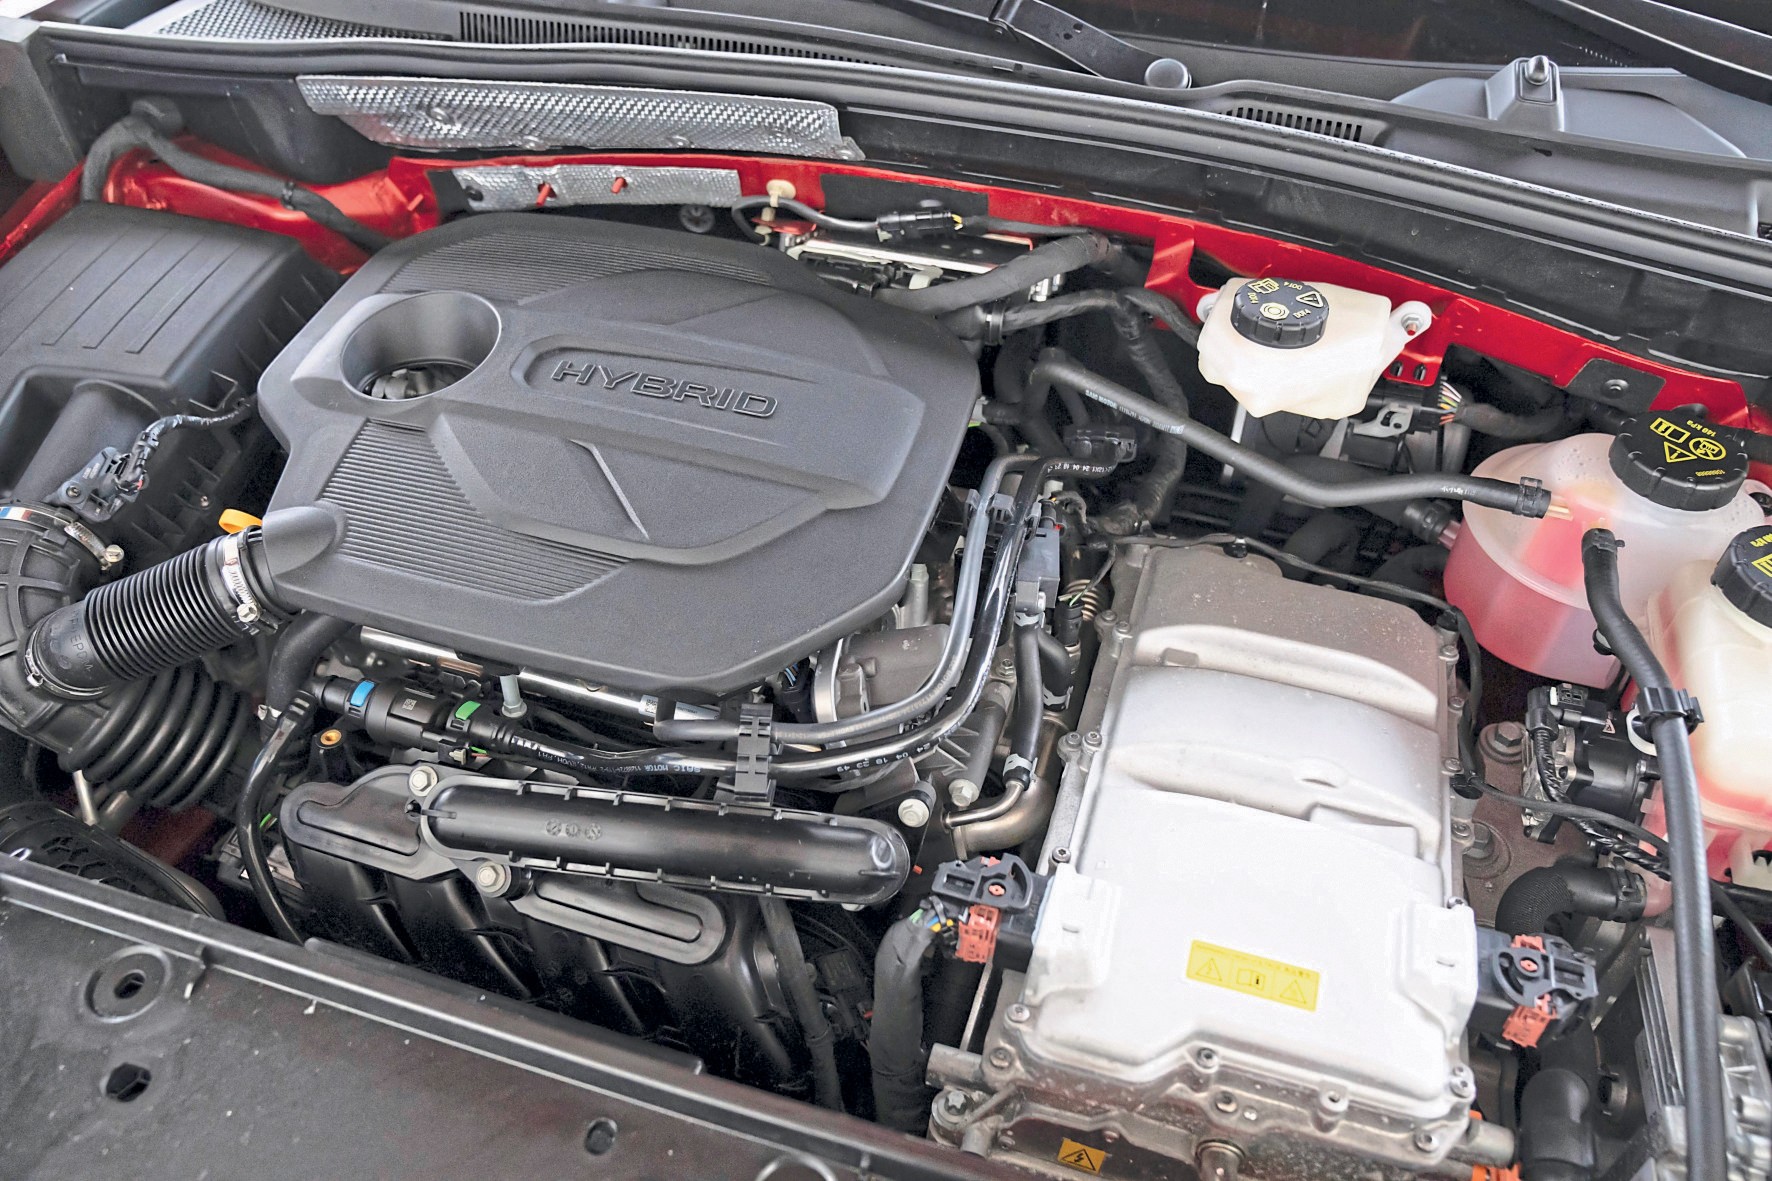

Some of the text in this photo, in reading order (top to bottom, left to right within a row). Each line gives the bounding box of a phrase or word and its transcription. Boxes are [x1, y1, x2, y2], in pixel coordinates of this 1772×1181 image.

[551, 360, 777, 417] HYBRID
[916, 742, 931, 753] 24
[895, 751, 909, 760] 04
[643, 763, 669, 772] MOTOR
[674, 764, 701, 773] SAIC
[836, 764, 851, 773] 49
[856, 760, 870, 769] 23
